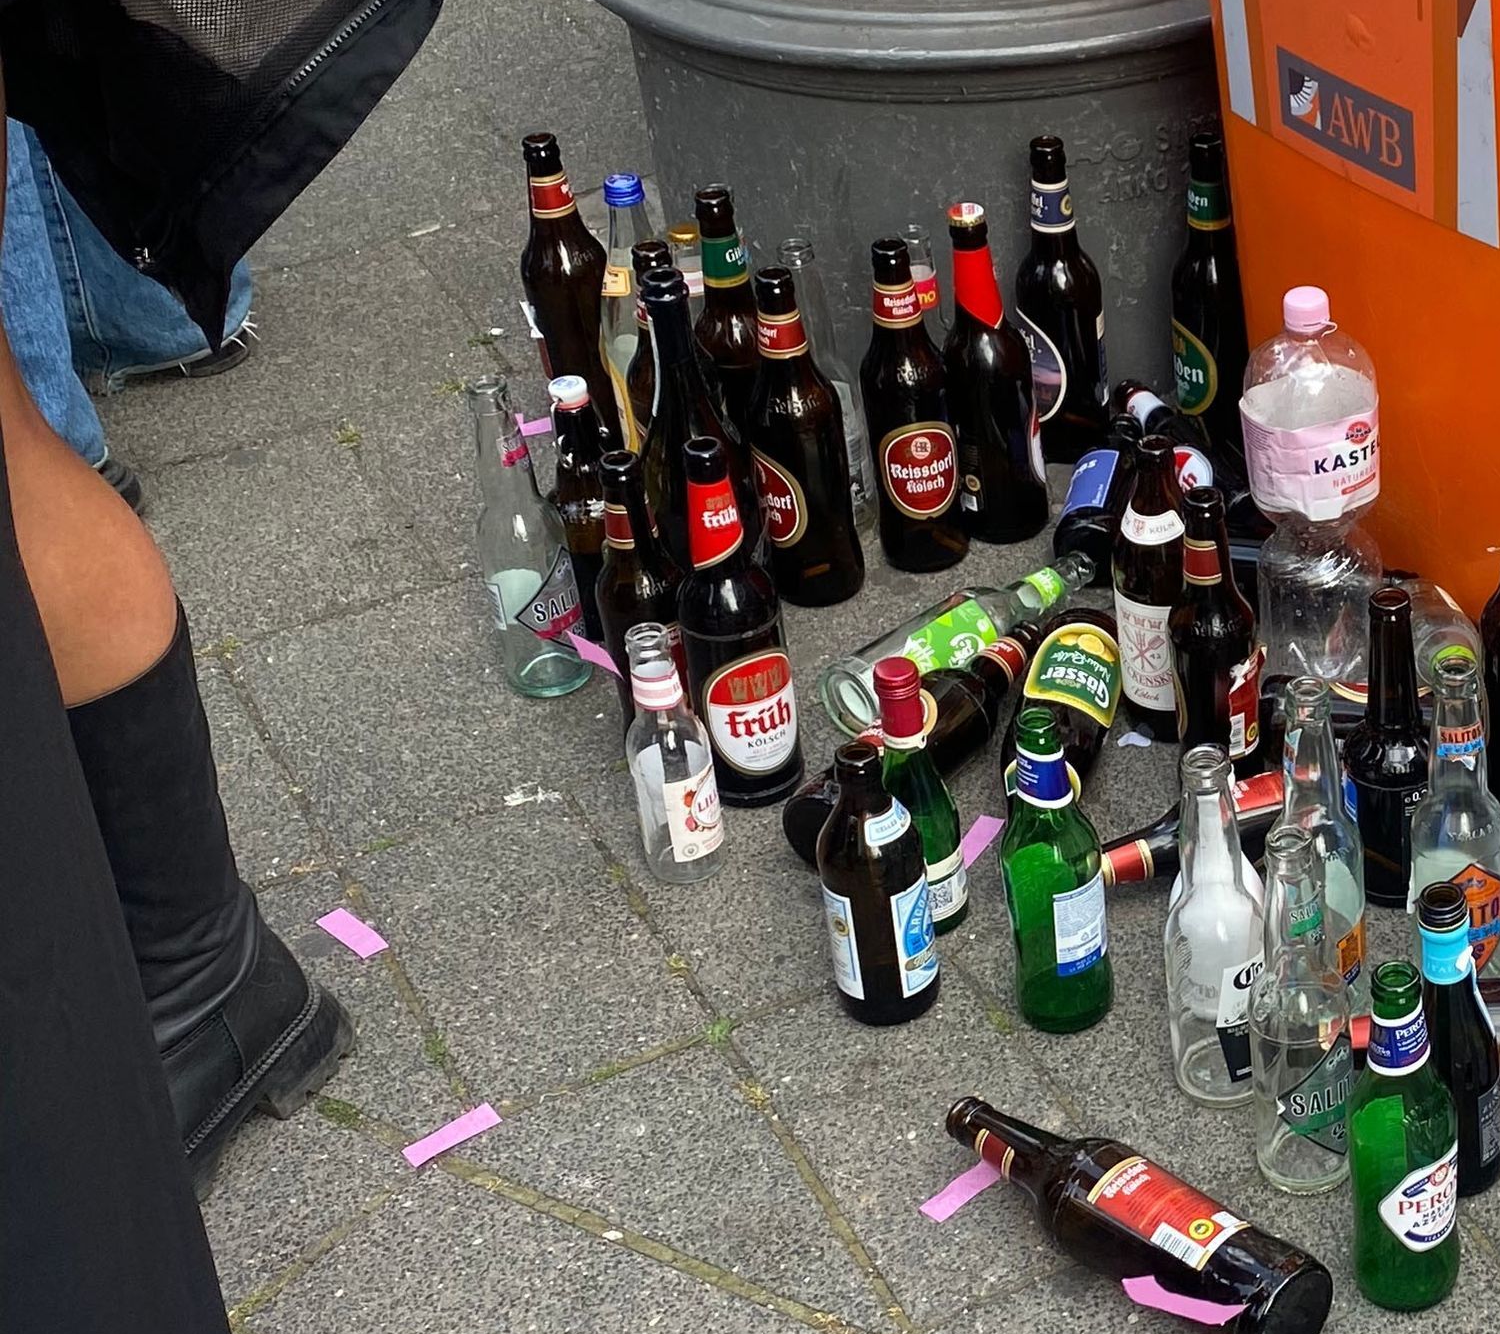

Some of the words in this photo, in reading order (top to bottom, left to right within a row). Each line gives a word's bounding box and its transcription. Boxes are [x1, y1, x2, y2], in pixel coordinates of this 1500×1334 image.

[1326, 92, 1404, 169] AWB
[890, 451, 954, 480] Reissdorf
[906, 474, 945, 495] Kölsch
[1039, 664, 1111, 710] Gösser
[746, 729, 788, 749] KÖLSCH
